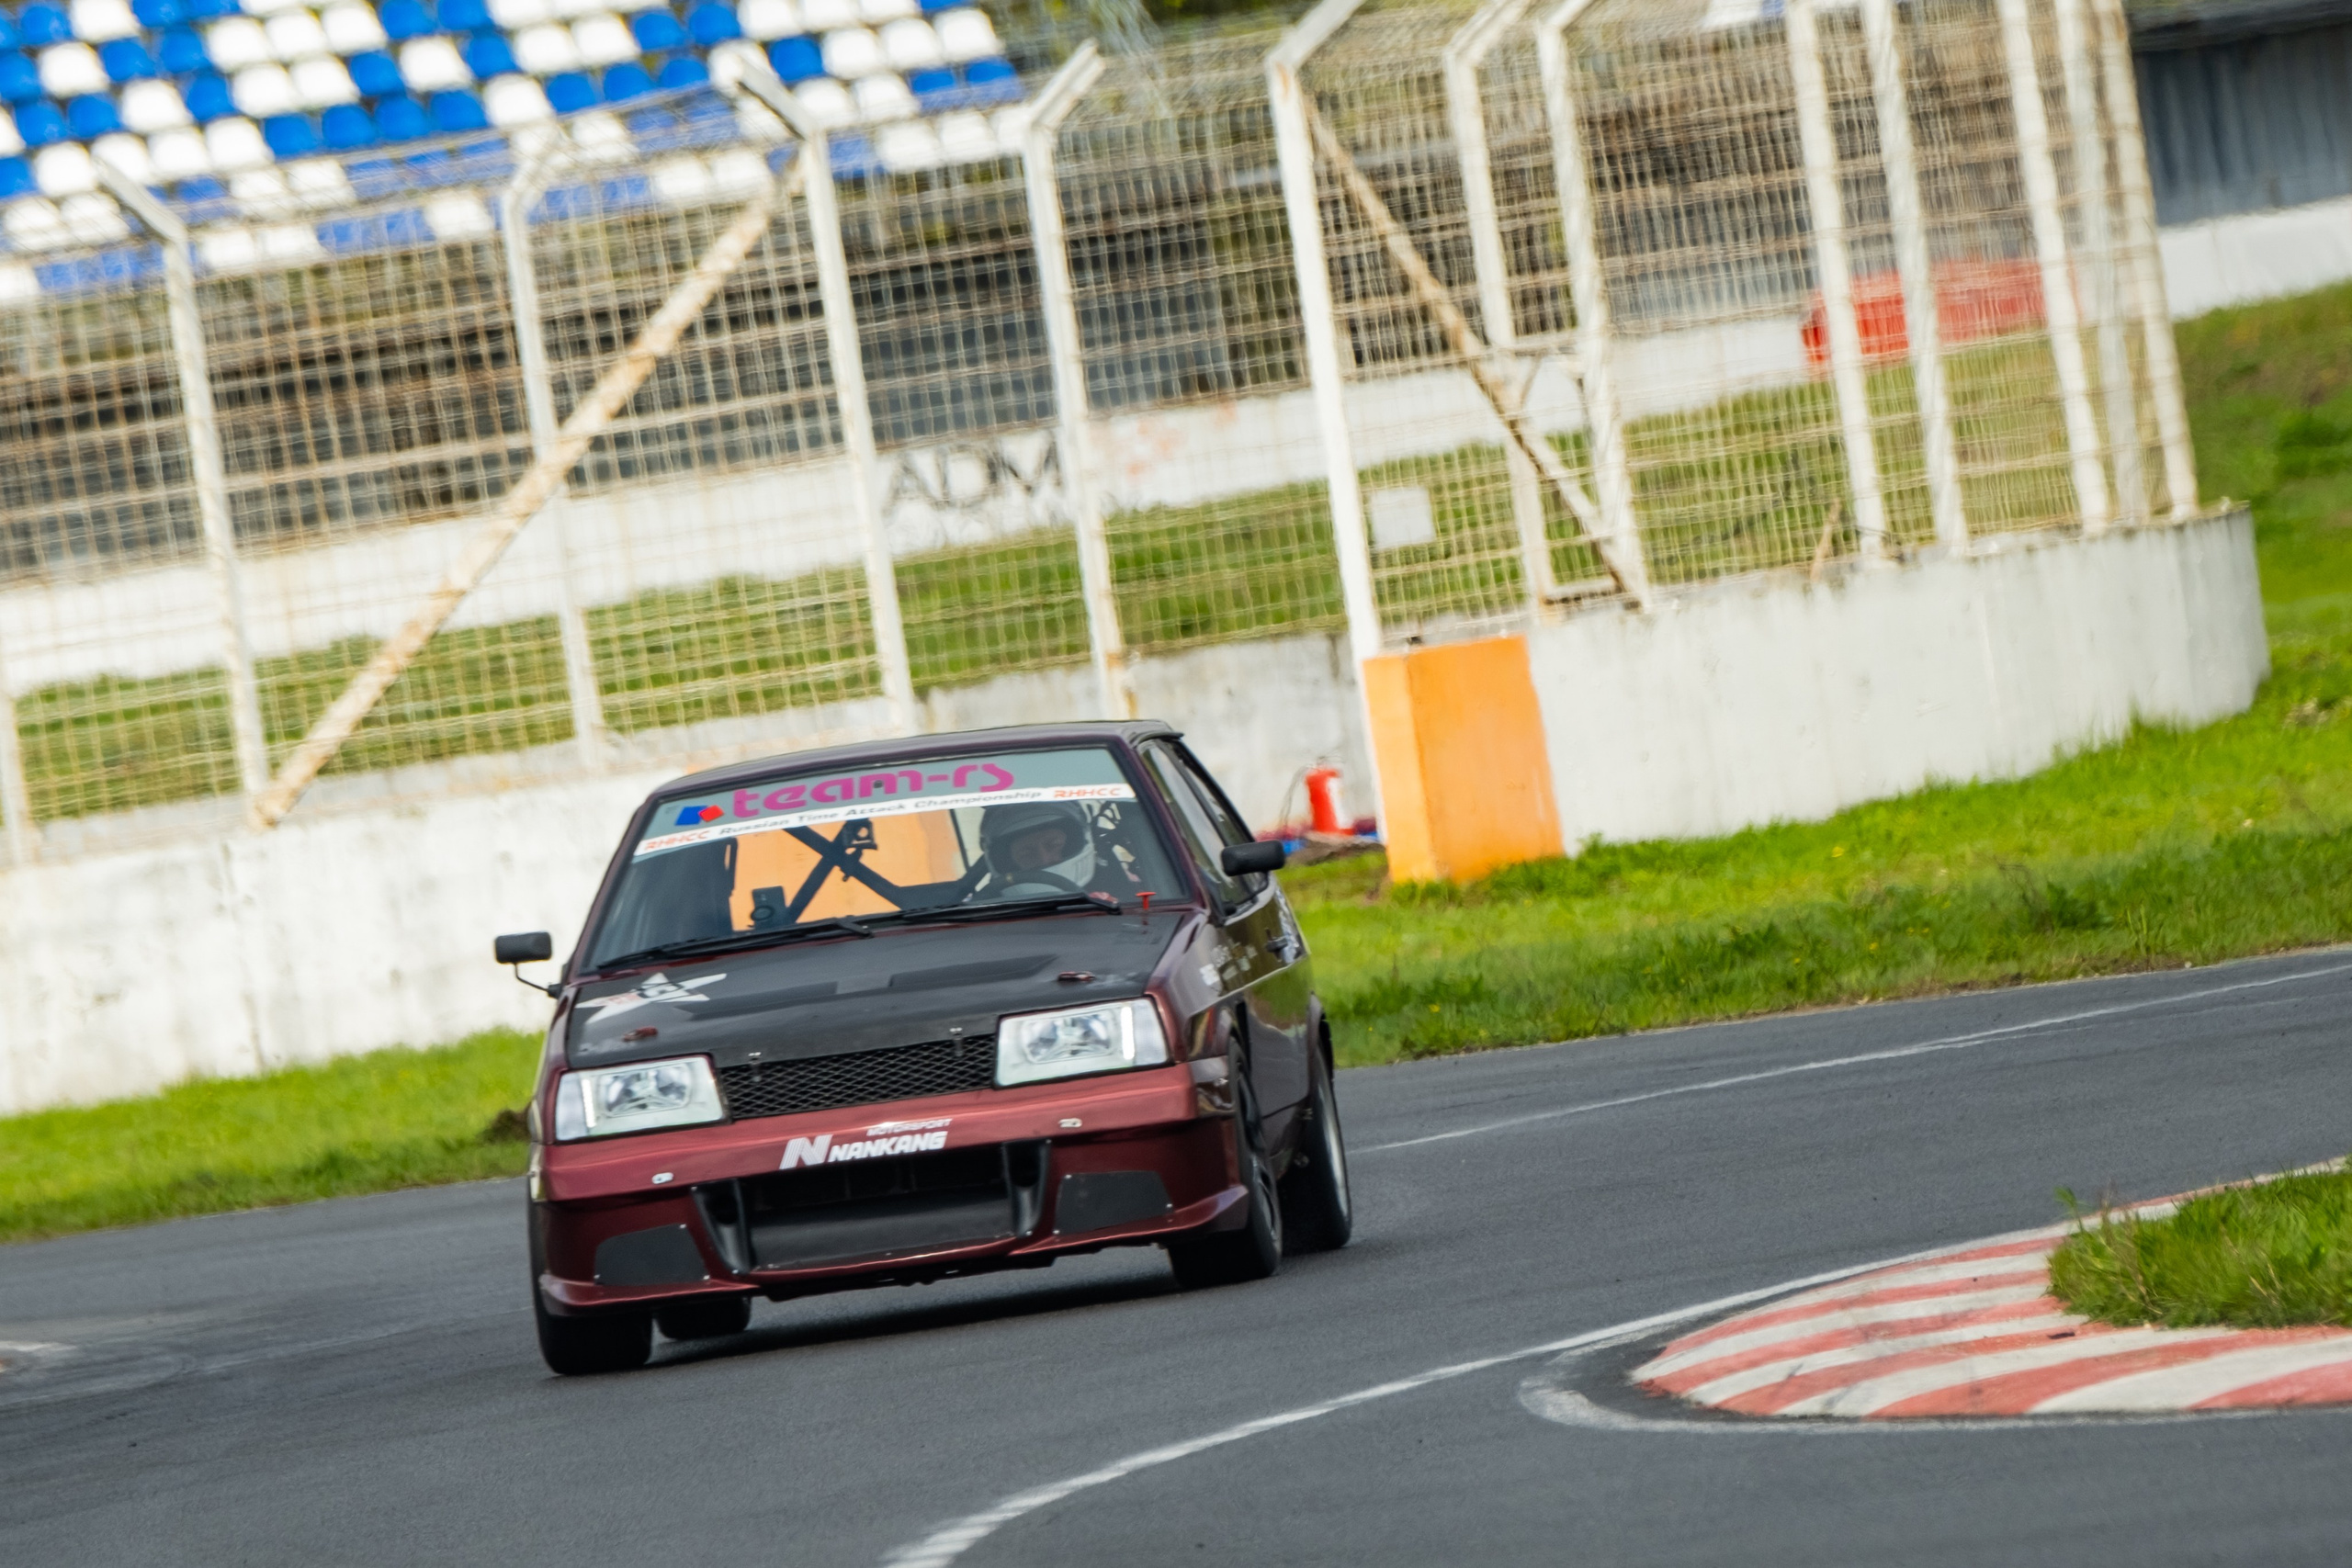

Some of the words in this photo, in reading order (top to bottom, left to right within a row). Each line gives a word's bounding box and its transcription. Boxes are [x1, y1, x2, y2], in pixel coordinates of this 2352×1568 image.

[719, 816, 790, 835] Russian
[797, 810, 838, 823] Time
[845, 802, 906, 818] Attack
[913, 790, 1043, 809] Championship
[1053, 786, 1122, 799] RHHCC
[732, 762, 1014, 818] team-rs
[828, 1131, 948, 1163] NANKANG
